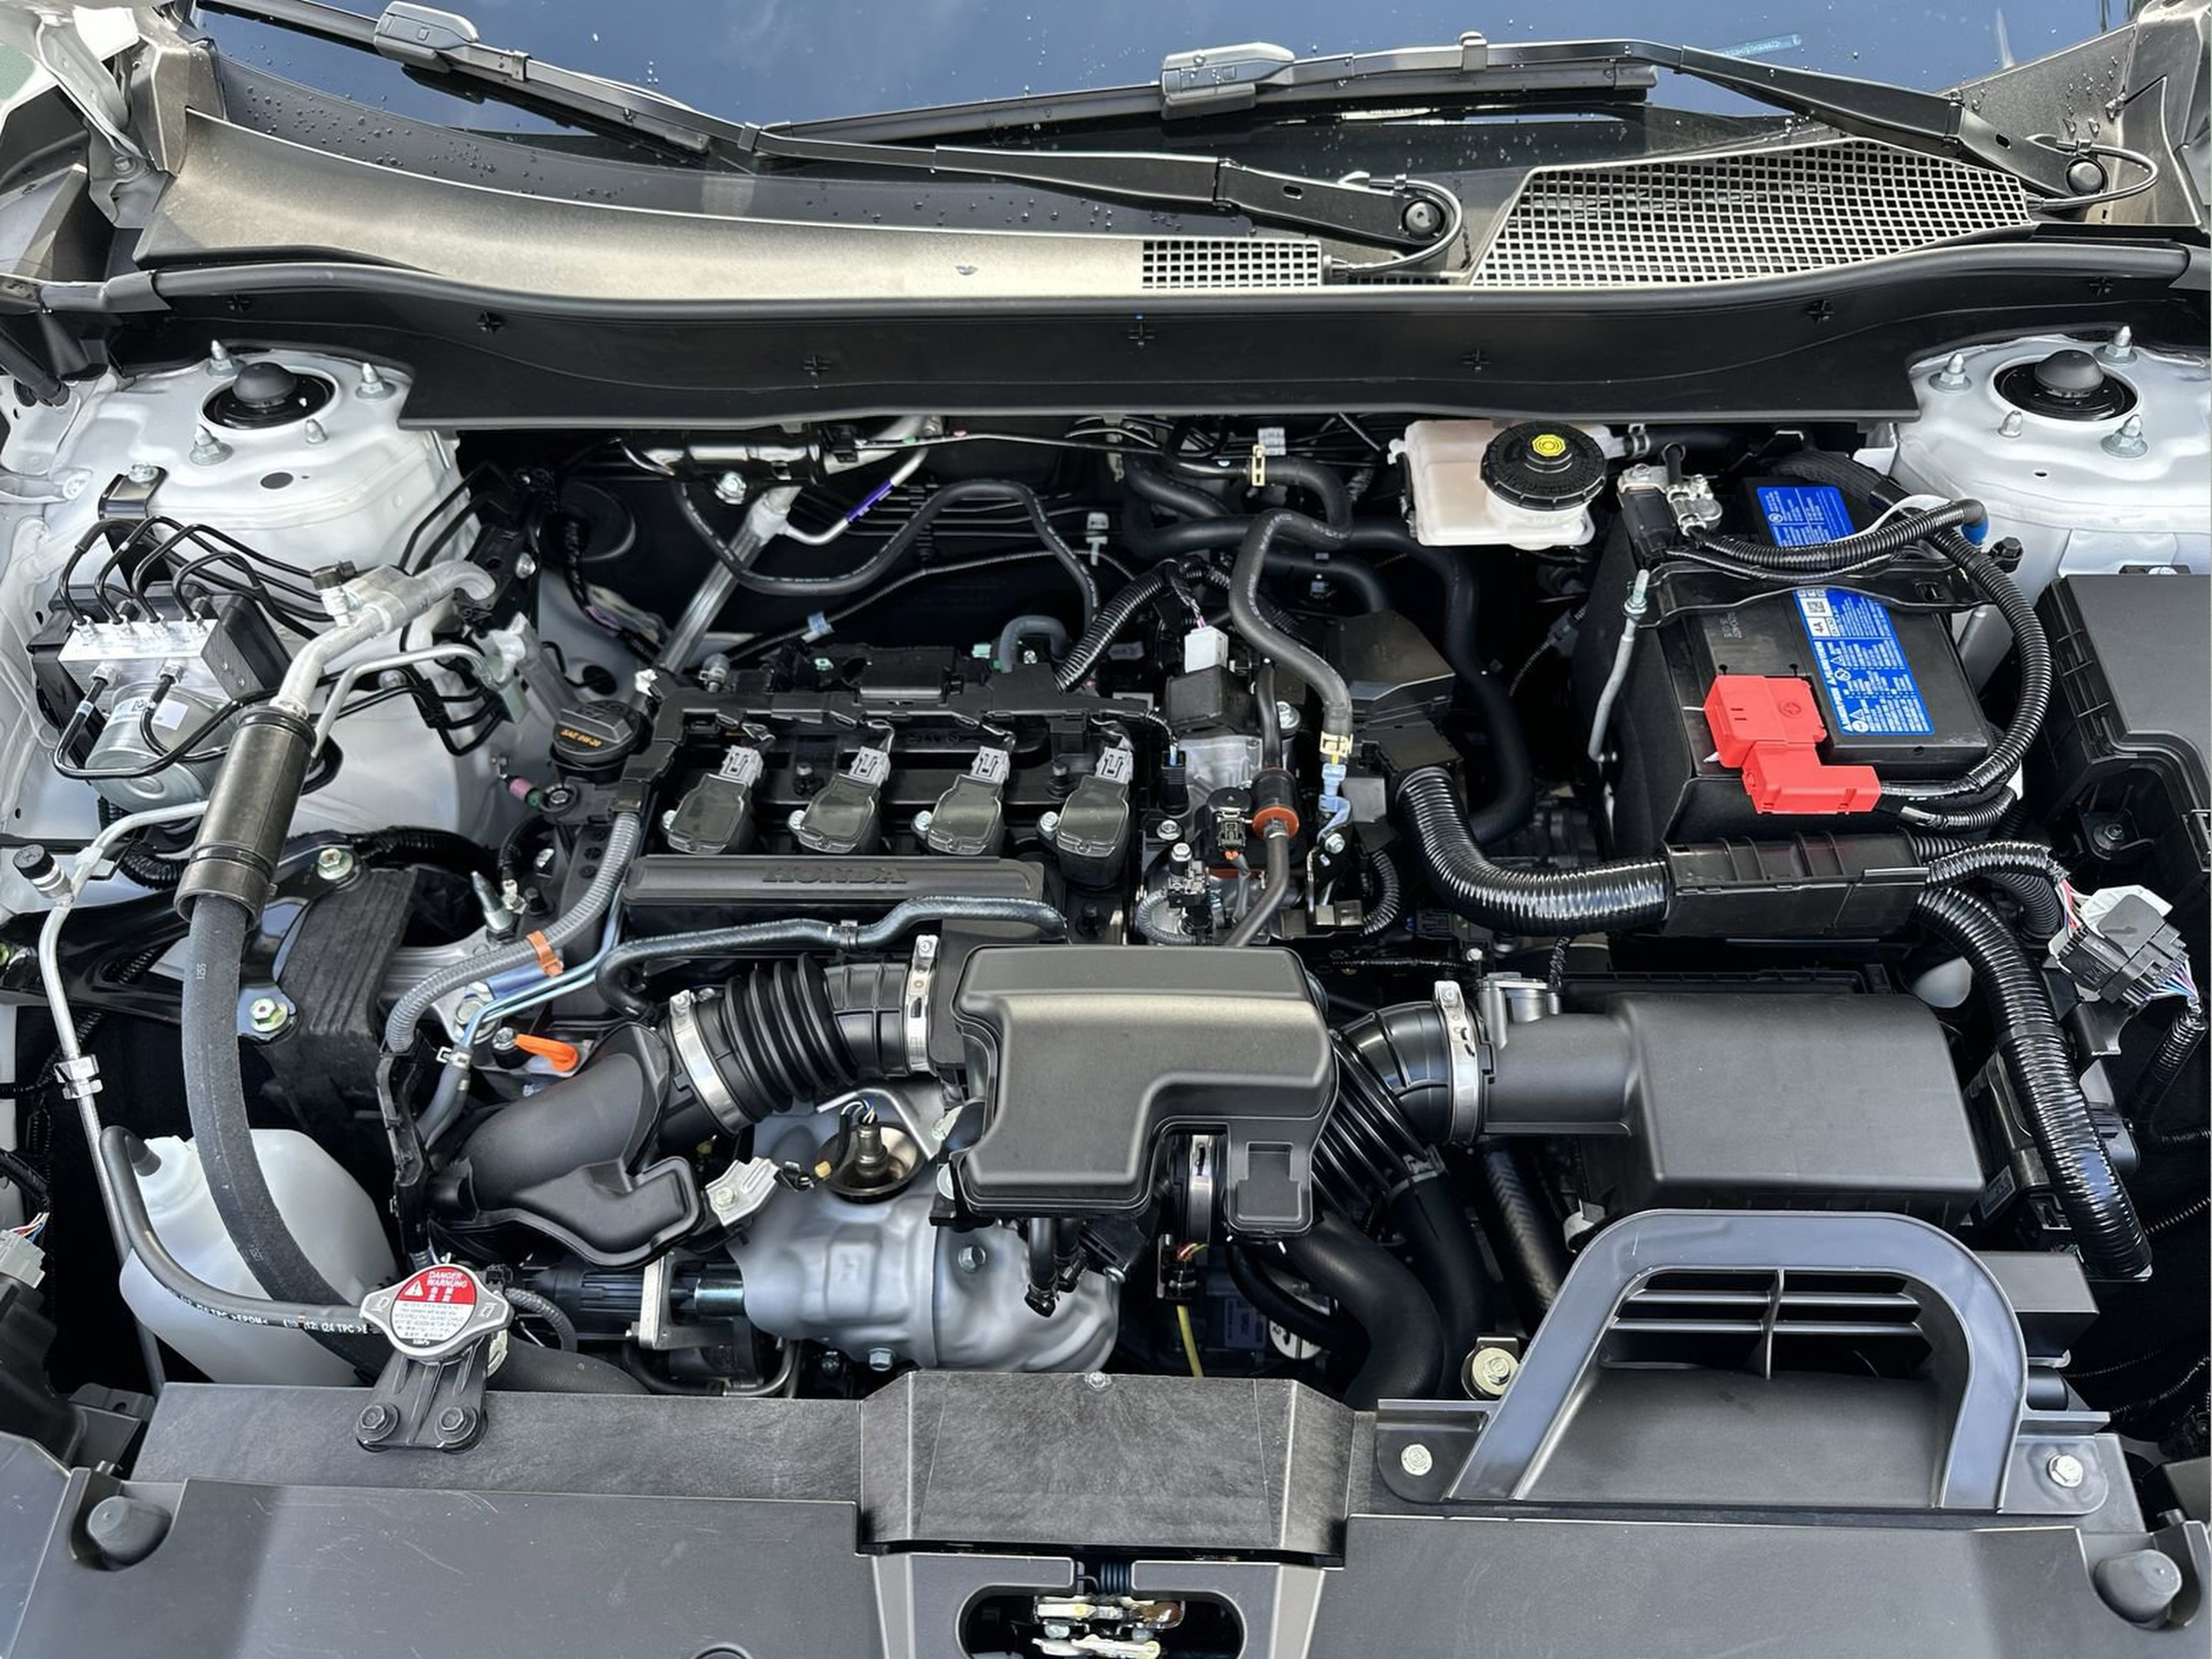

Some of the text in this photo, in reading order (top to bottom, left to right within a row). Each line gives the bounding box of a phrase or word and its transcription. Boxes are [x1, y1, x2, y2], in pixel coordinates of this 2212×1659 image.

[561, 729, 580, 739] SAE
[763, 866, 907, 884] HONDA
[429, 1270, 464, 1280] DANGER
[336, 1323, 355, 1334] TPC
